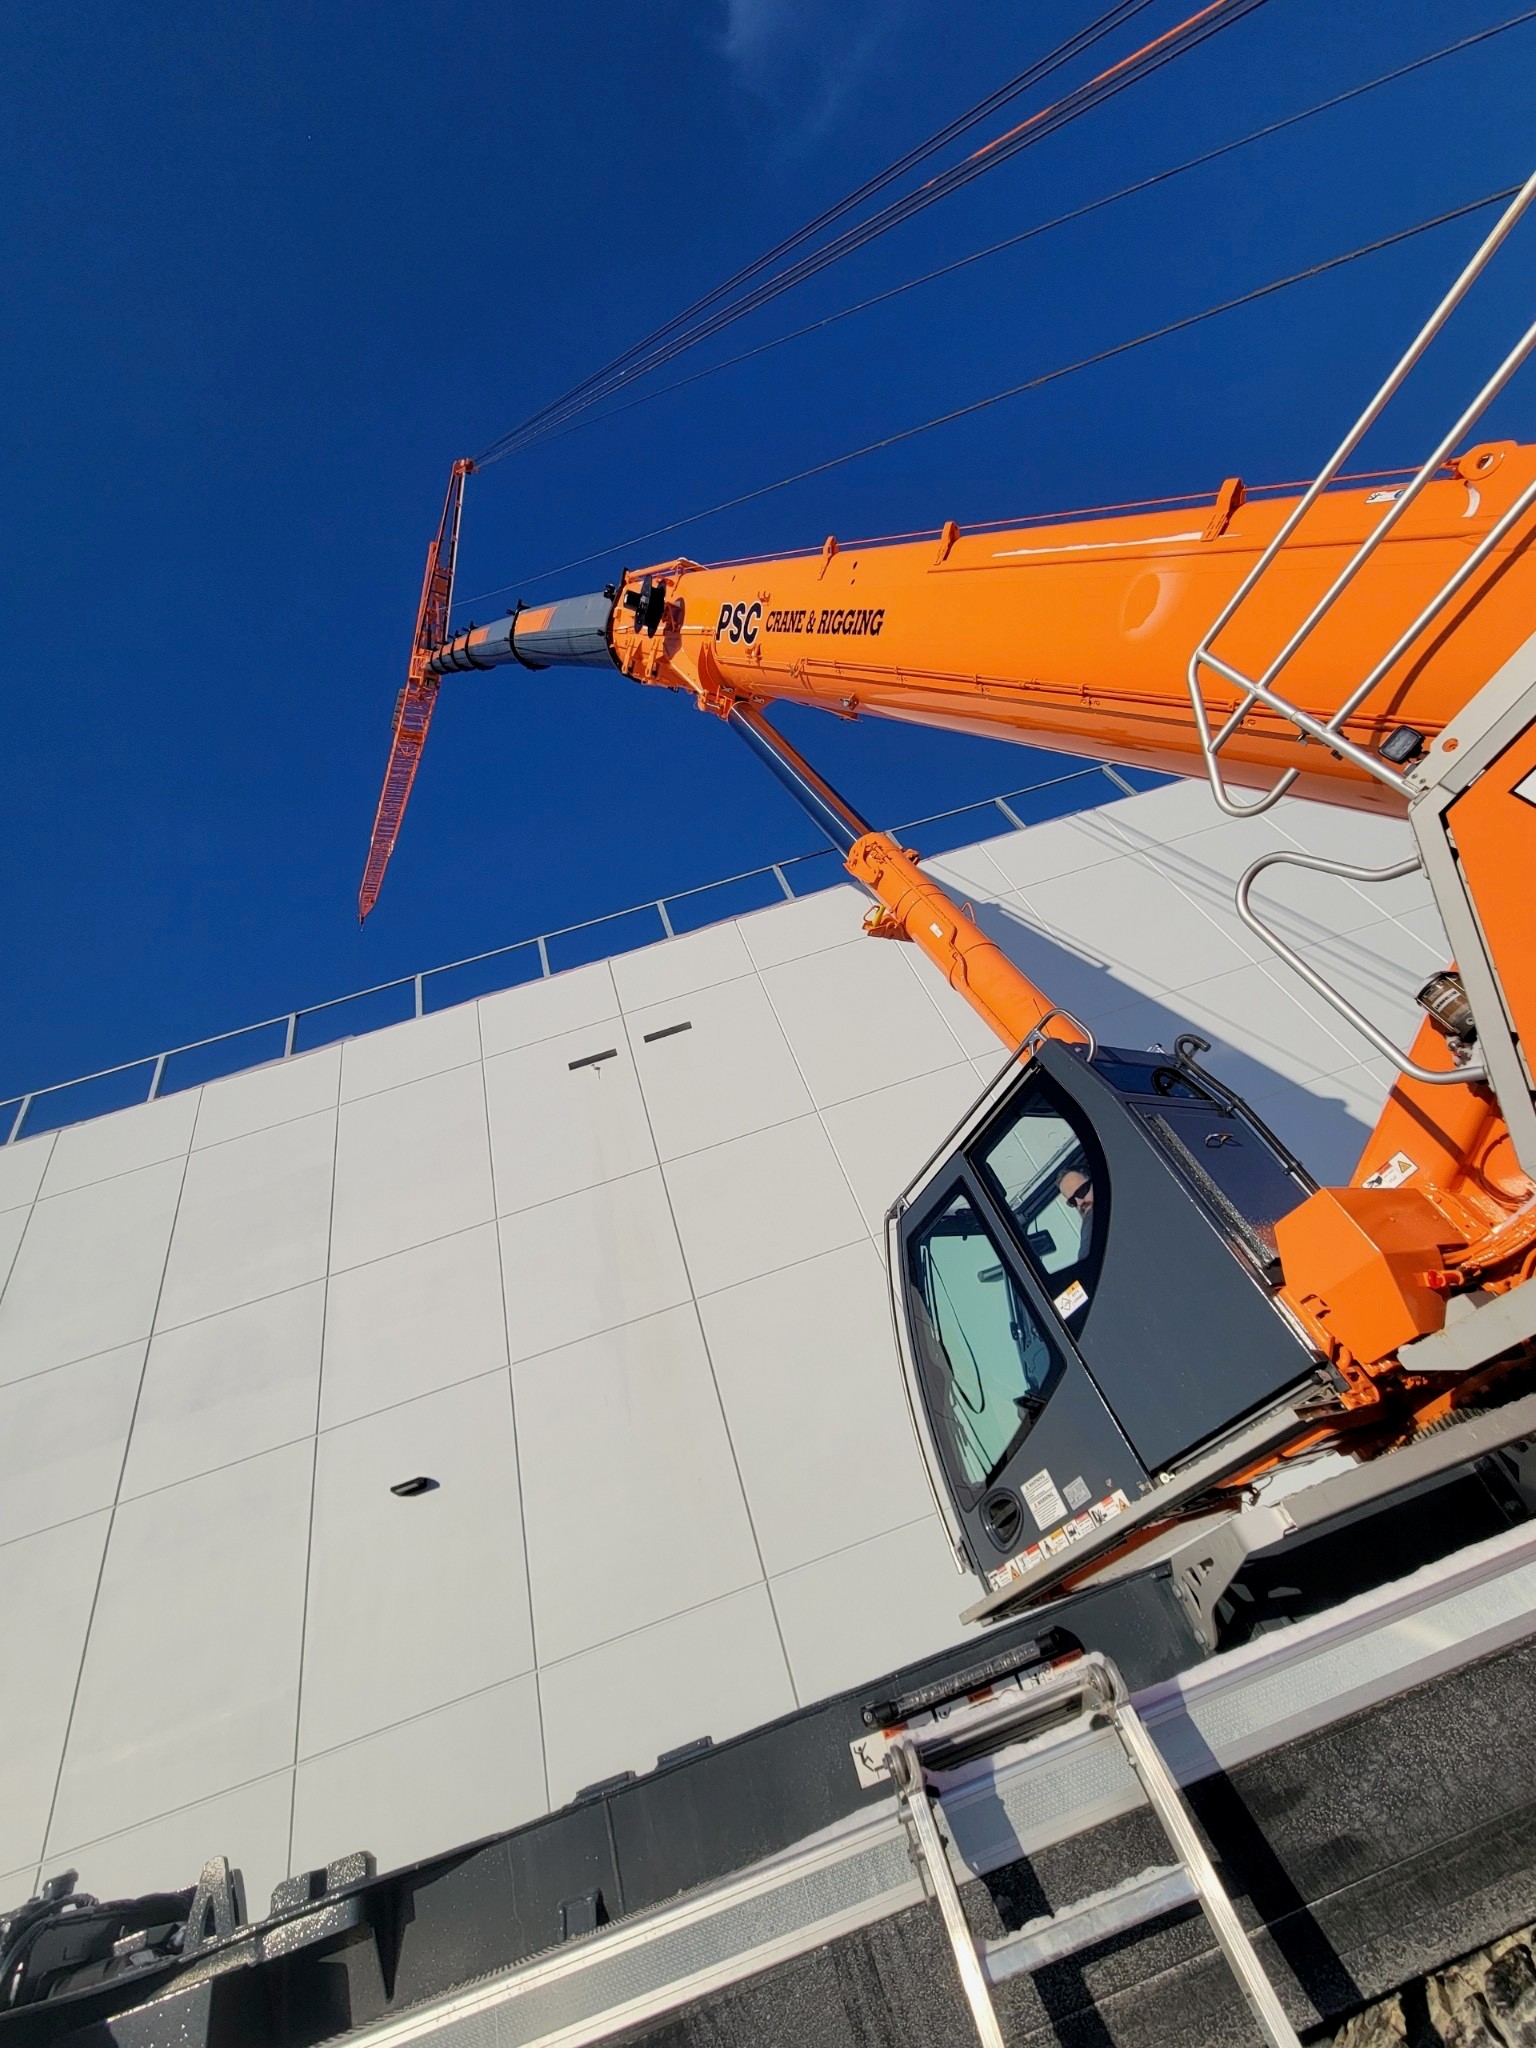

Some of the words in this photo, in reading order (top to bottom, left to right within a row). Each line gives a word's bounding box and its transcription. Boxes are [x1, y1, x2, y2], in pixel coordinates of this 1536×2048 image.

[715, 602, 762, 645] PSC
[765, 610, 806, 633] CRANE
[805, 611, 817, 634] &
[817, 609, 885, 636] RIGGING
